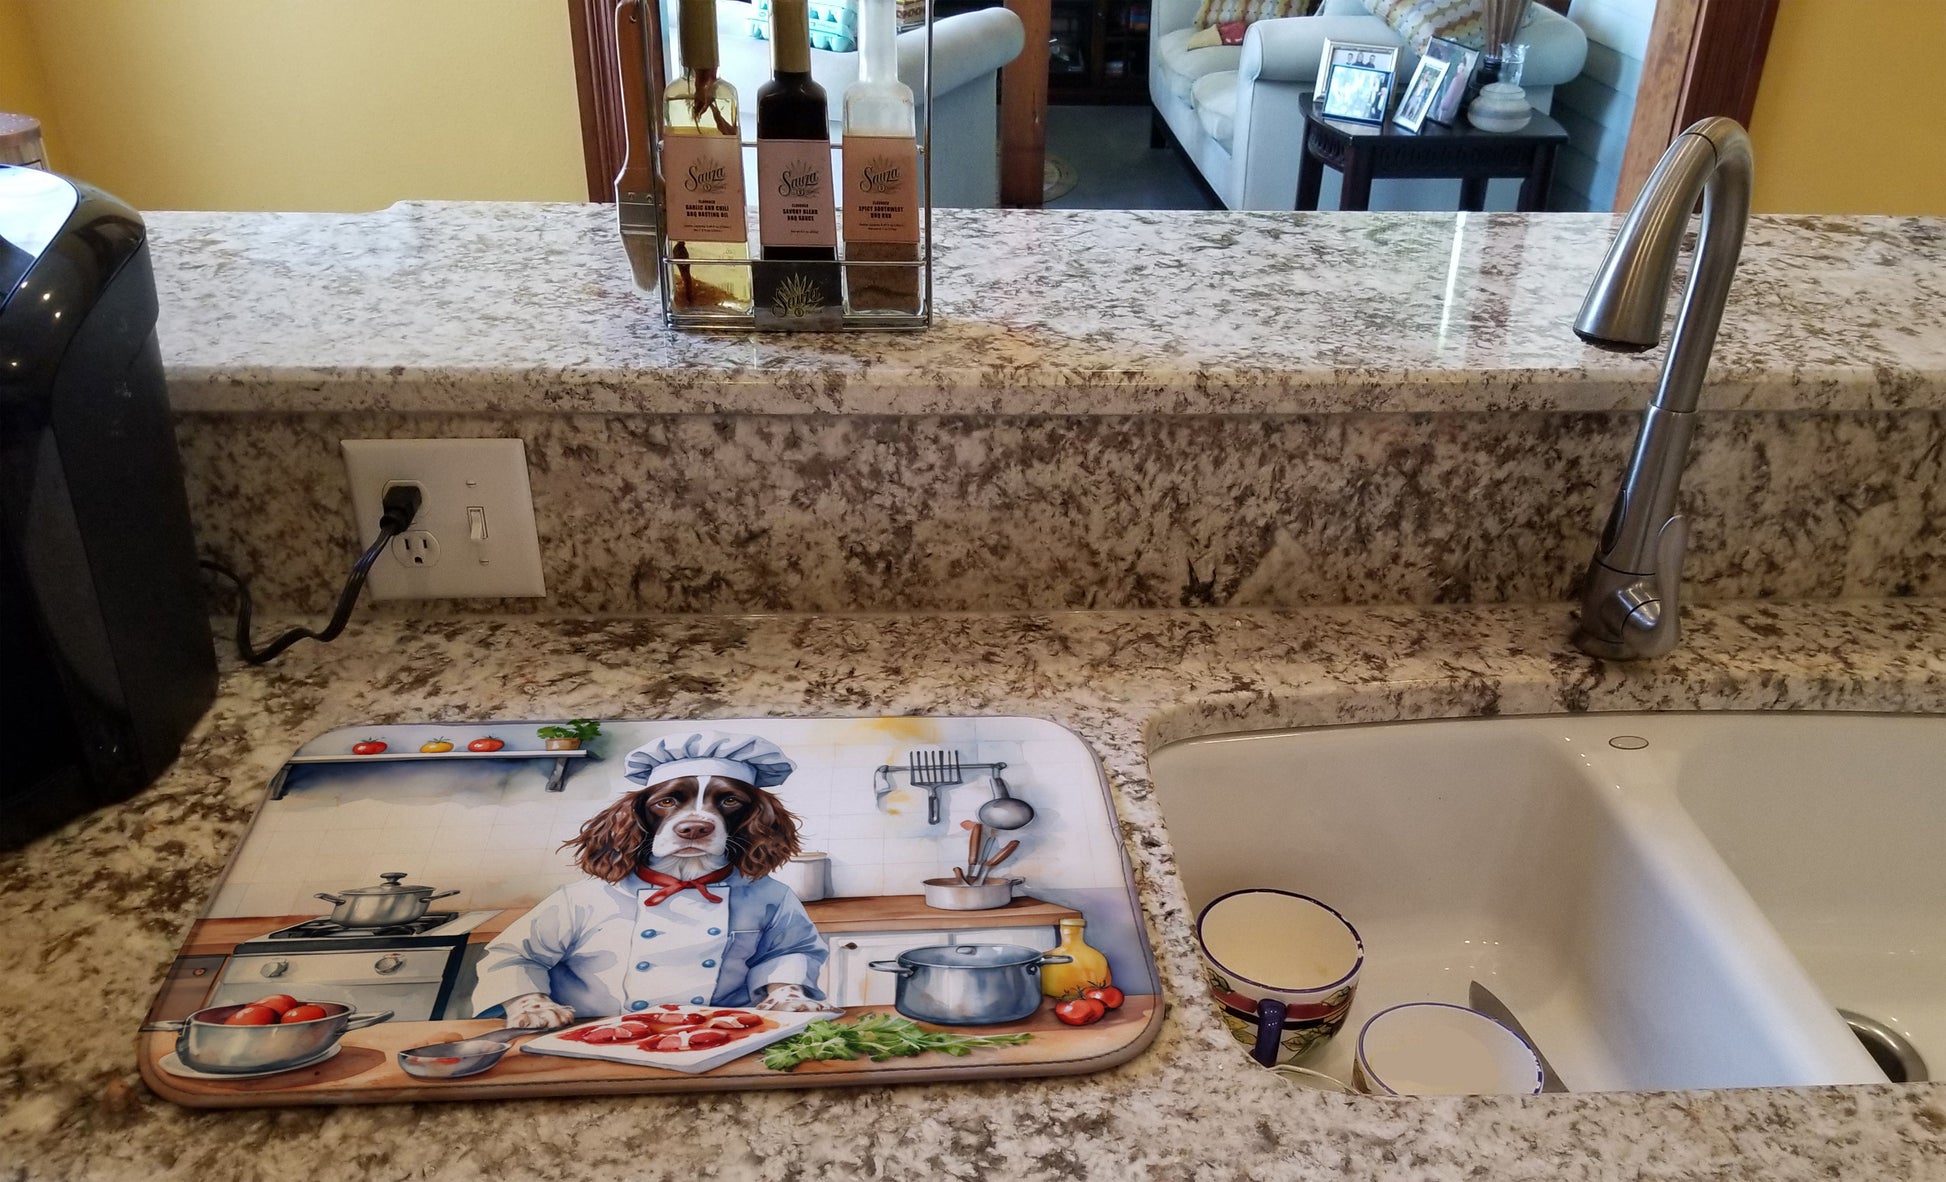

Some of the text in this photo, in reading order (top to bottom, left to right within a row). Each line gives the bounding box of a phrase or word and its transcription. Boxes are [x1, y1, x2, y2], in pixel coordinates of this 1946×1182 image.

[685, 165, 725, 192] Sauza
[778, 170, 818, 196] Sauza
[860, 166, 898, 192] Sauza
